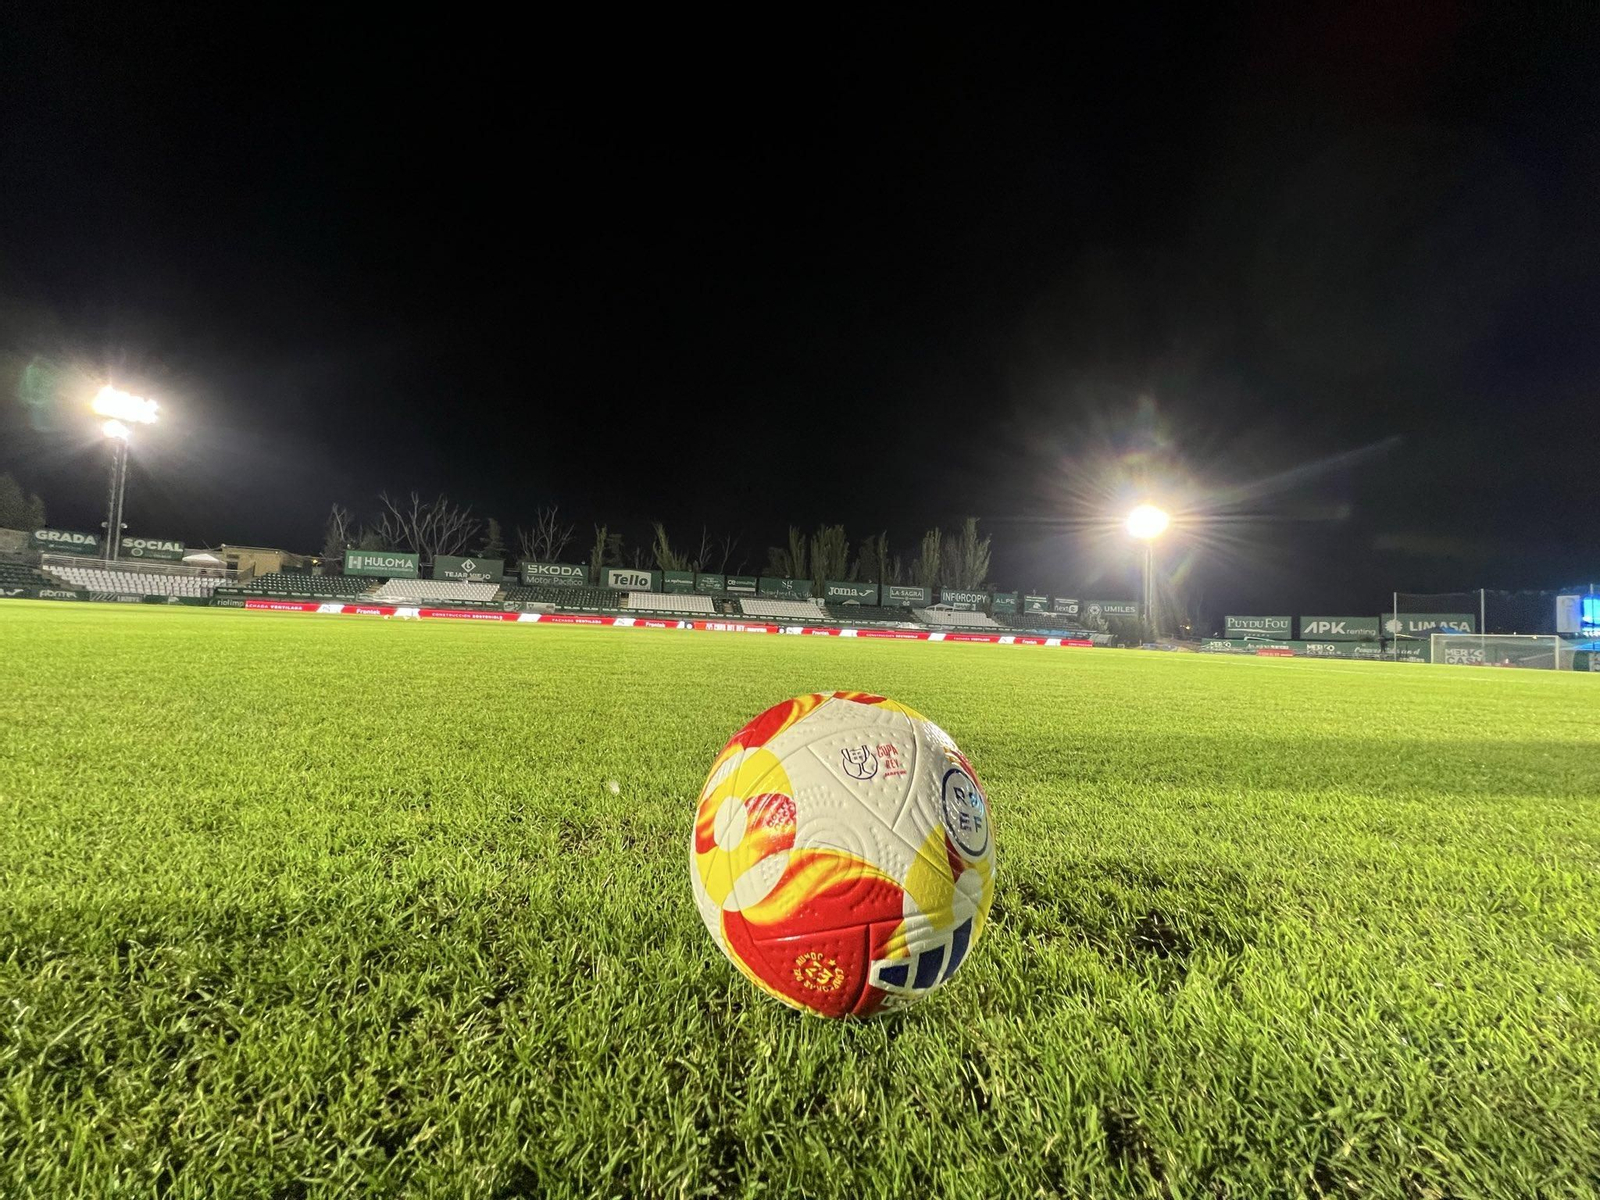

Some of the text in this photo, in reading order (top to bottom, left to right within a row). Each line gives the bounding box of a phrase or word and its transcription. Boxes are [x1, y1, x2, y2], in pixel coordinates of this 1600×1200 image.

[35, 530, 97, 546] GRADA
[122, 538, 184, 553] SOCIAL
[364, 556, 414, 569] HULOMA
[526, 576, 552, 585] Motor
[613, 573, 649, 587] Tello
[942, 592, 987, 604] INFORCOPY
[1104, 605, 1136, 613] UMILES
[1304, 621, 1376, 636] APK renting
[1409, 620, 1471, 633] LIMASA
[876, 744, 898, 758] COPA
[885, 759, 899, 769] REY
